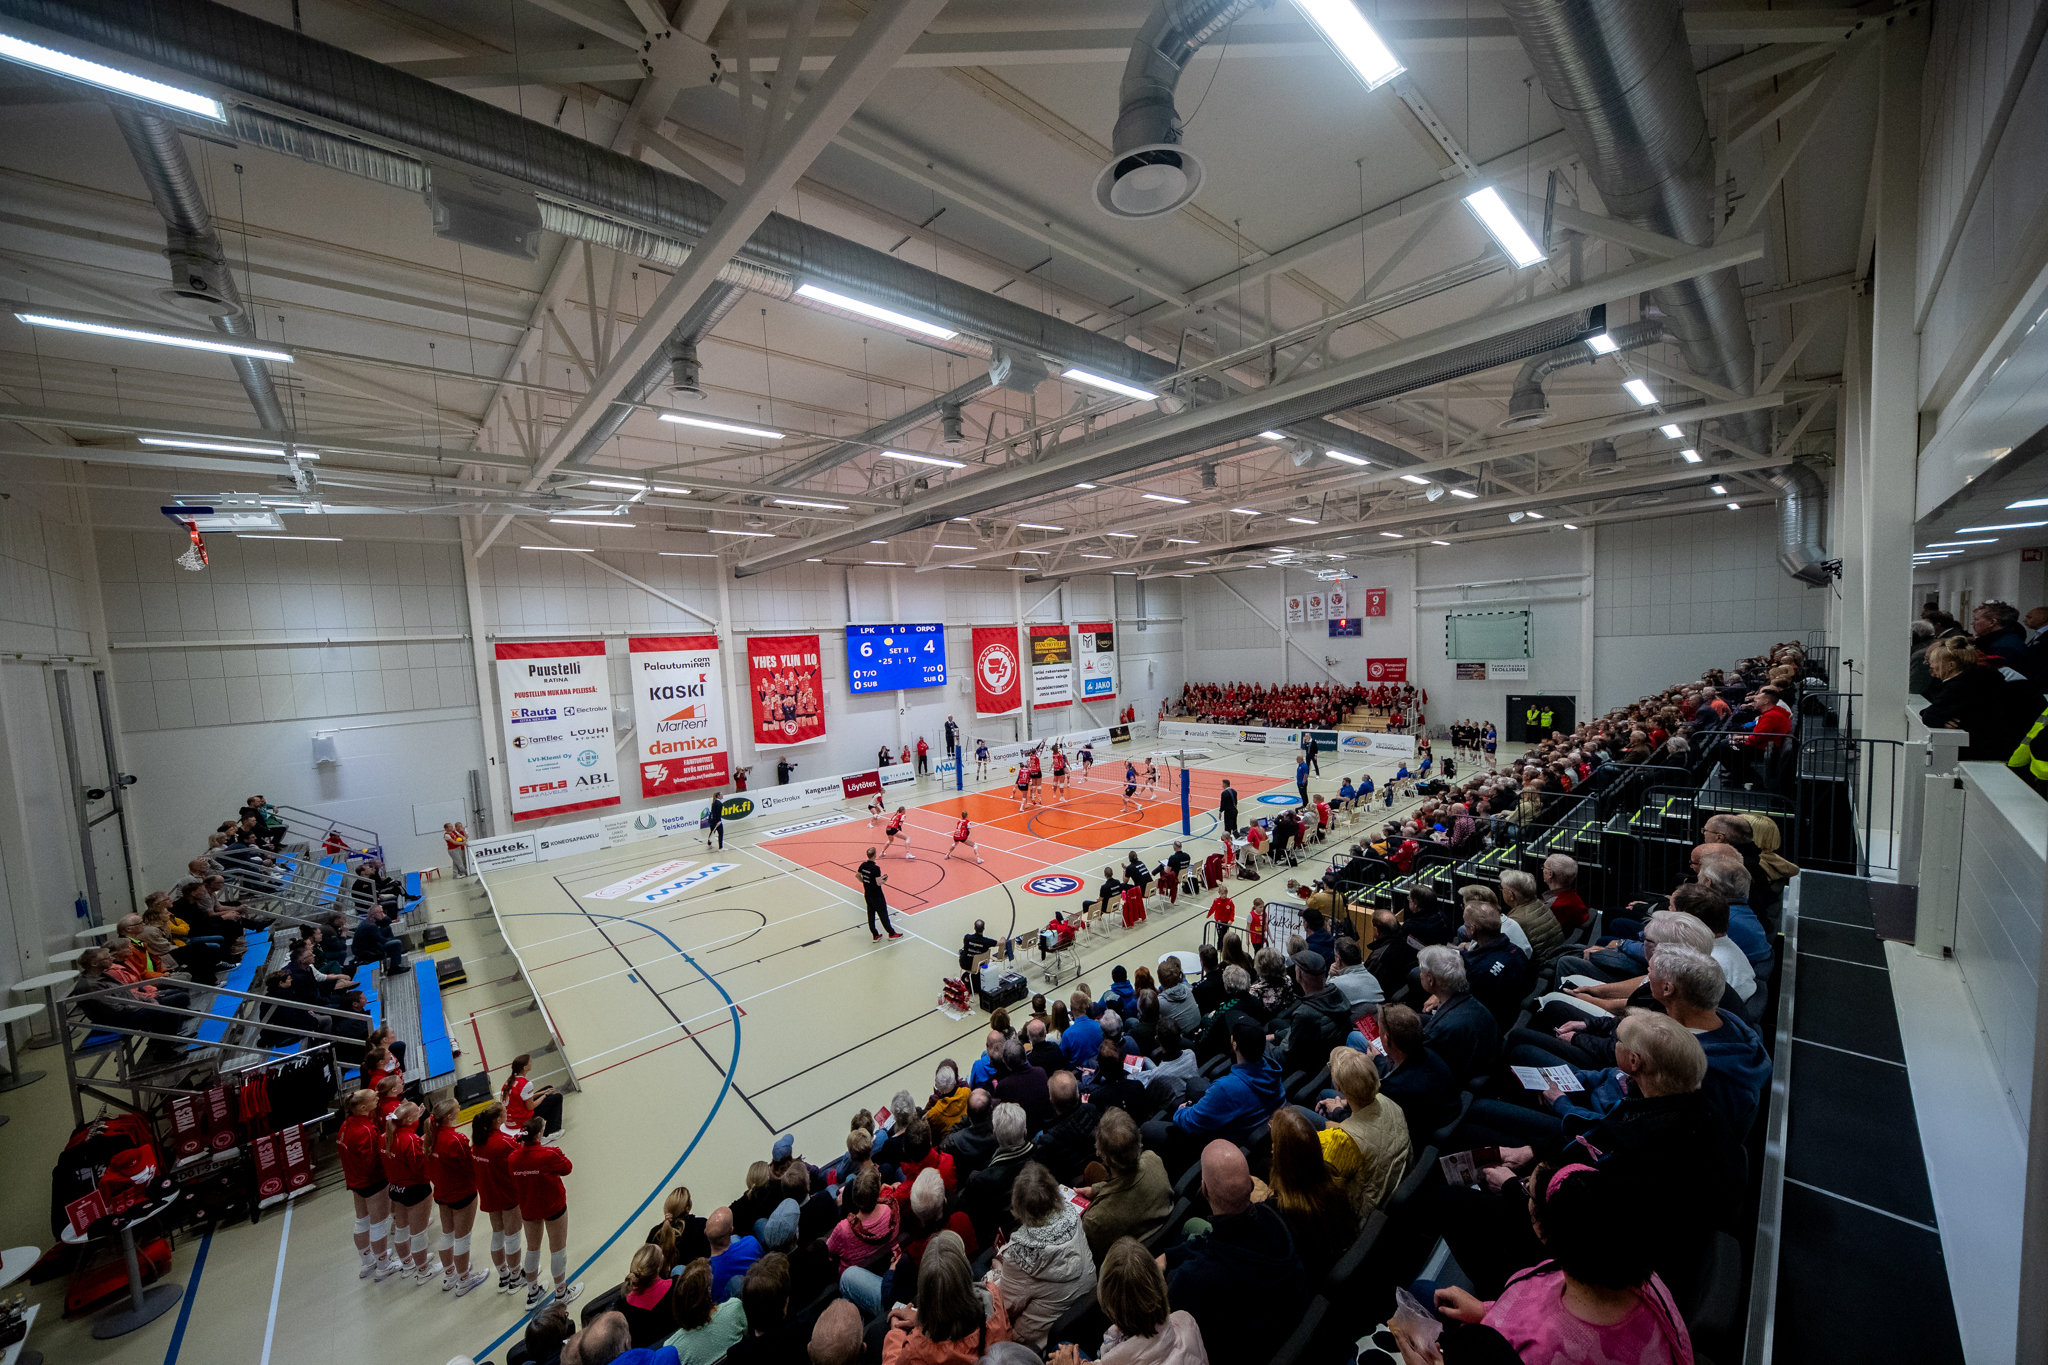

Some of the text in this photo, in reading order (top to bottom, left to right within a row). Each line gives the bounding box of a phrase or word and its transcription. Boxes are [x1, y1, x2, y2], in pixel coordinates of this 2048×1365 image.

[1372, 596, 1379, 605] 9
[860, 642, 873, 657] 6
[924, 640, 935, 653] 4
[753, 653, 817, 668] YHES YLIN ILO
[980, 646, 1015, 669] KANGASALA
[529, 662, 581, 677] Puustelli
[644, 660, 710, 671] Palautuminen
[937, 664, 943, 672] 0
[853, 670, 861, 679] 0
[937, 674, 944, 682] 0
[854, 681, 862, 690] 0
[1095, 681, 1110, 690] JAKO
[514, 686, 598, 698] PUUSTELLIN MUKANA PELEISSÄ:
[576, 706, 607, 714] Electrolux
[571, 727, 608, 736] LOUHI
[656, 718, 708, 733] MarRent
[528, 735, 564, 743] TamElec
[649, 736, 718, 755] damixa
[489, 757, 494, 765] 1
[575, 773, 614, 787] ABL
[847, 780, 877, 792] Löytötex
[805, 784, 840, 795] Kangasalan
[773, 795, 800, 804] Electrolux
[662, 816, 684, 824] Neste
[663, 820, 699, 831] Teiskontie
[551, 833, 599, 846] KONEOSAPALVELU
[475, 842, 529, 858] ahutek.
[646, 865, 730, 901] MALM
[1034, 877, 1075, 892] HK
[175, 1106, 196, 1133] YHES
[258, 1142, 275, 1170] YHES
[285, 1141, 304, 1167] YHES
